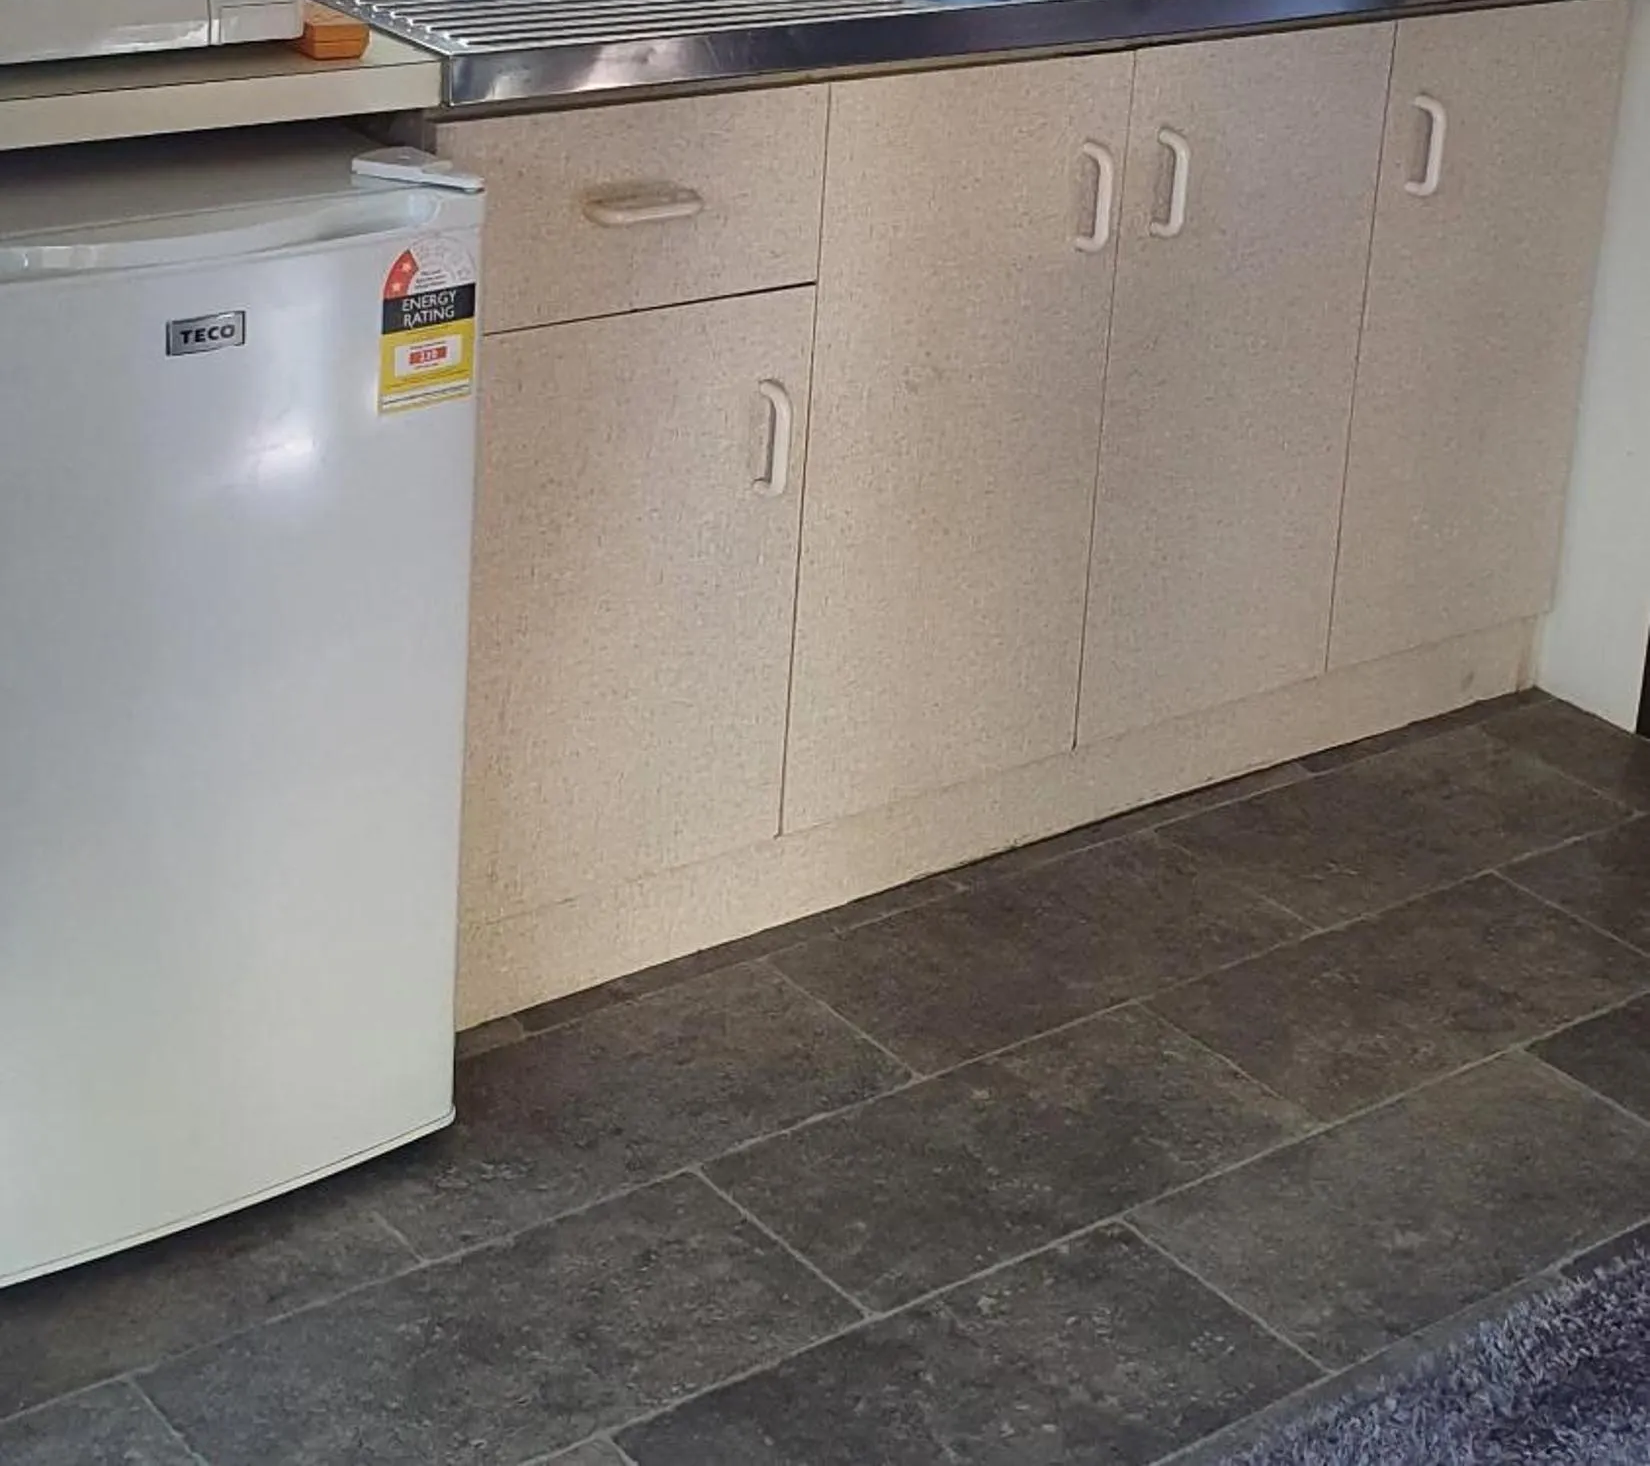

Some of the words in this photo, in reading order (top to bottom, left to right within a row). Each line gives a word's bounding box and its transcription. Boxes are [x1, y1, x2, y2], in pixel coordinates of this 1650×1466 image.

[402, 290, 457, 312] ENERGY
[404, 305, 455, 328] RATING
[180, 324, 236, 344] TECO
